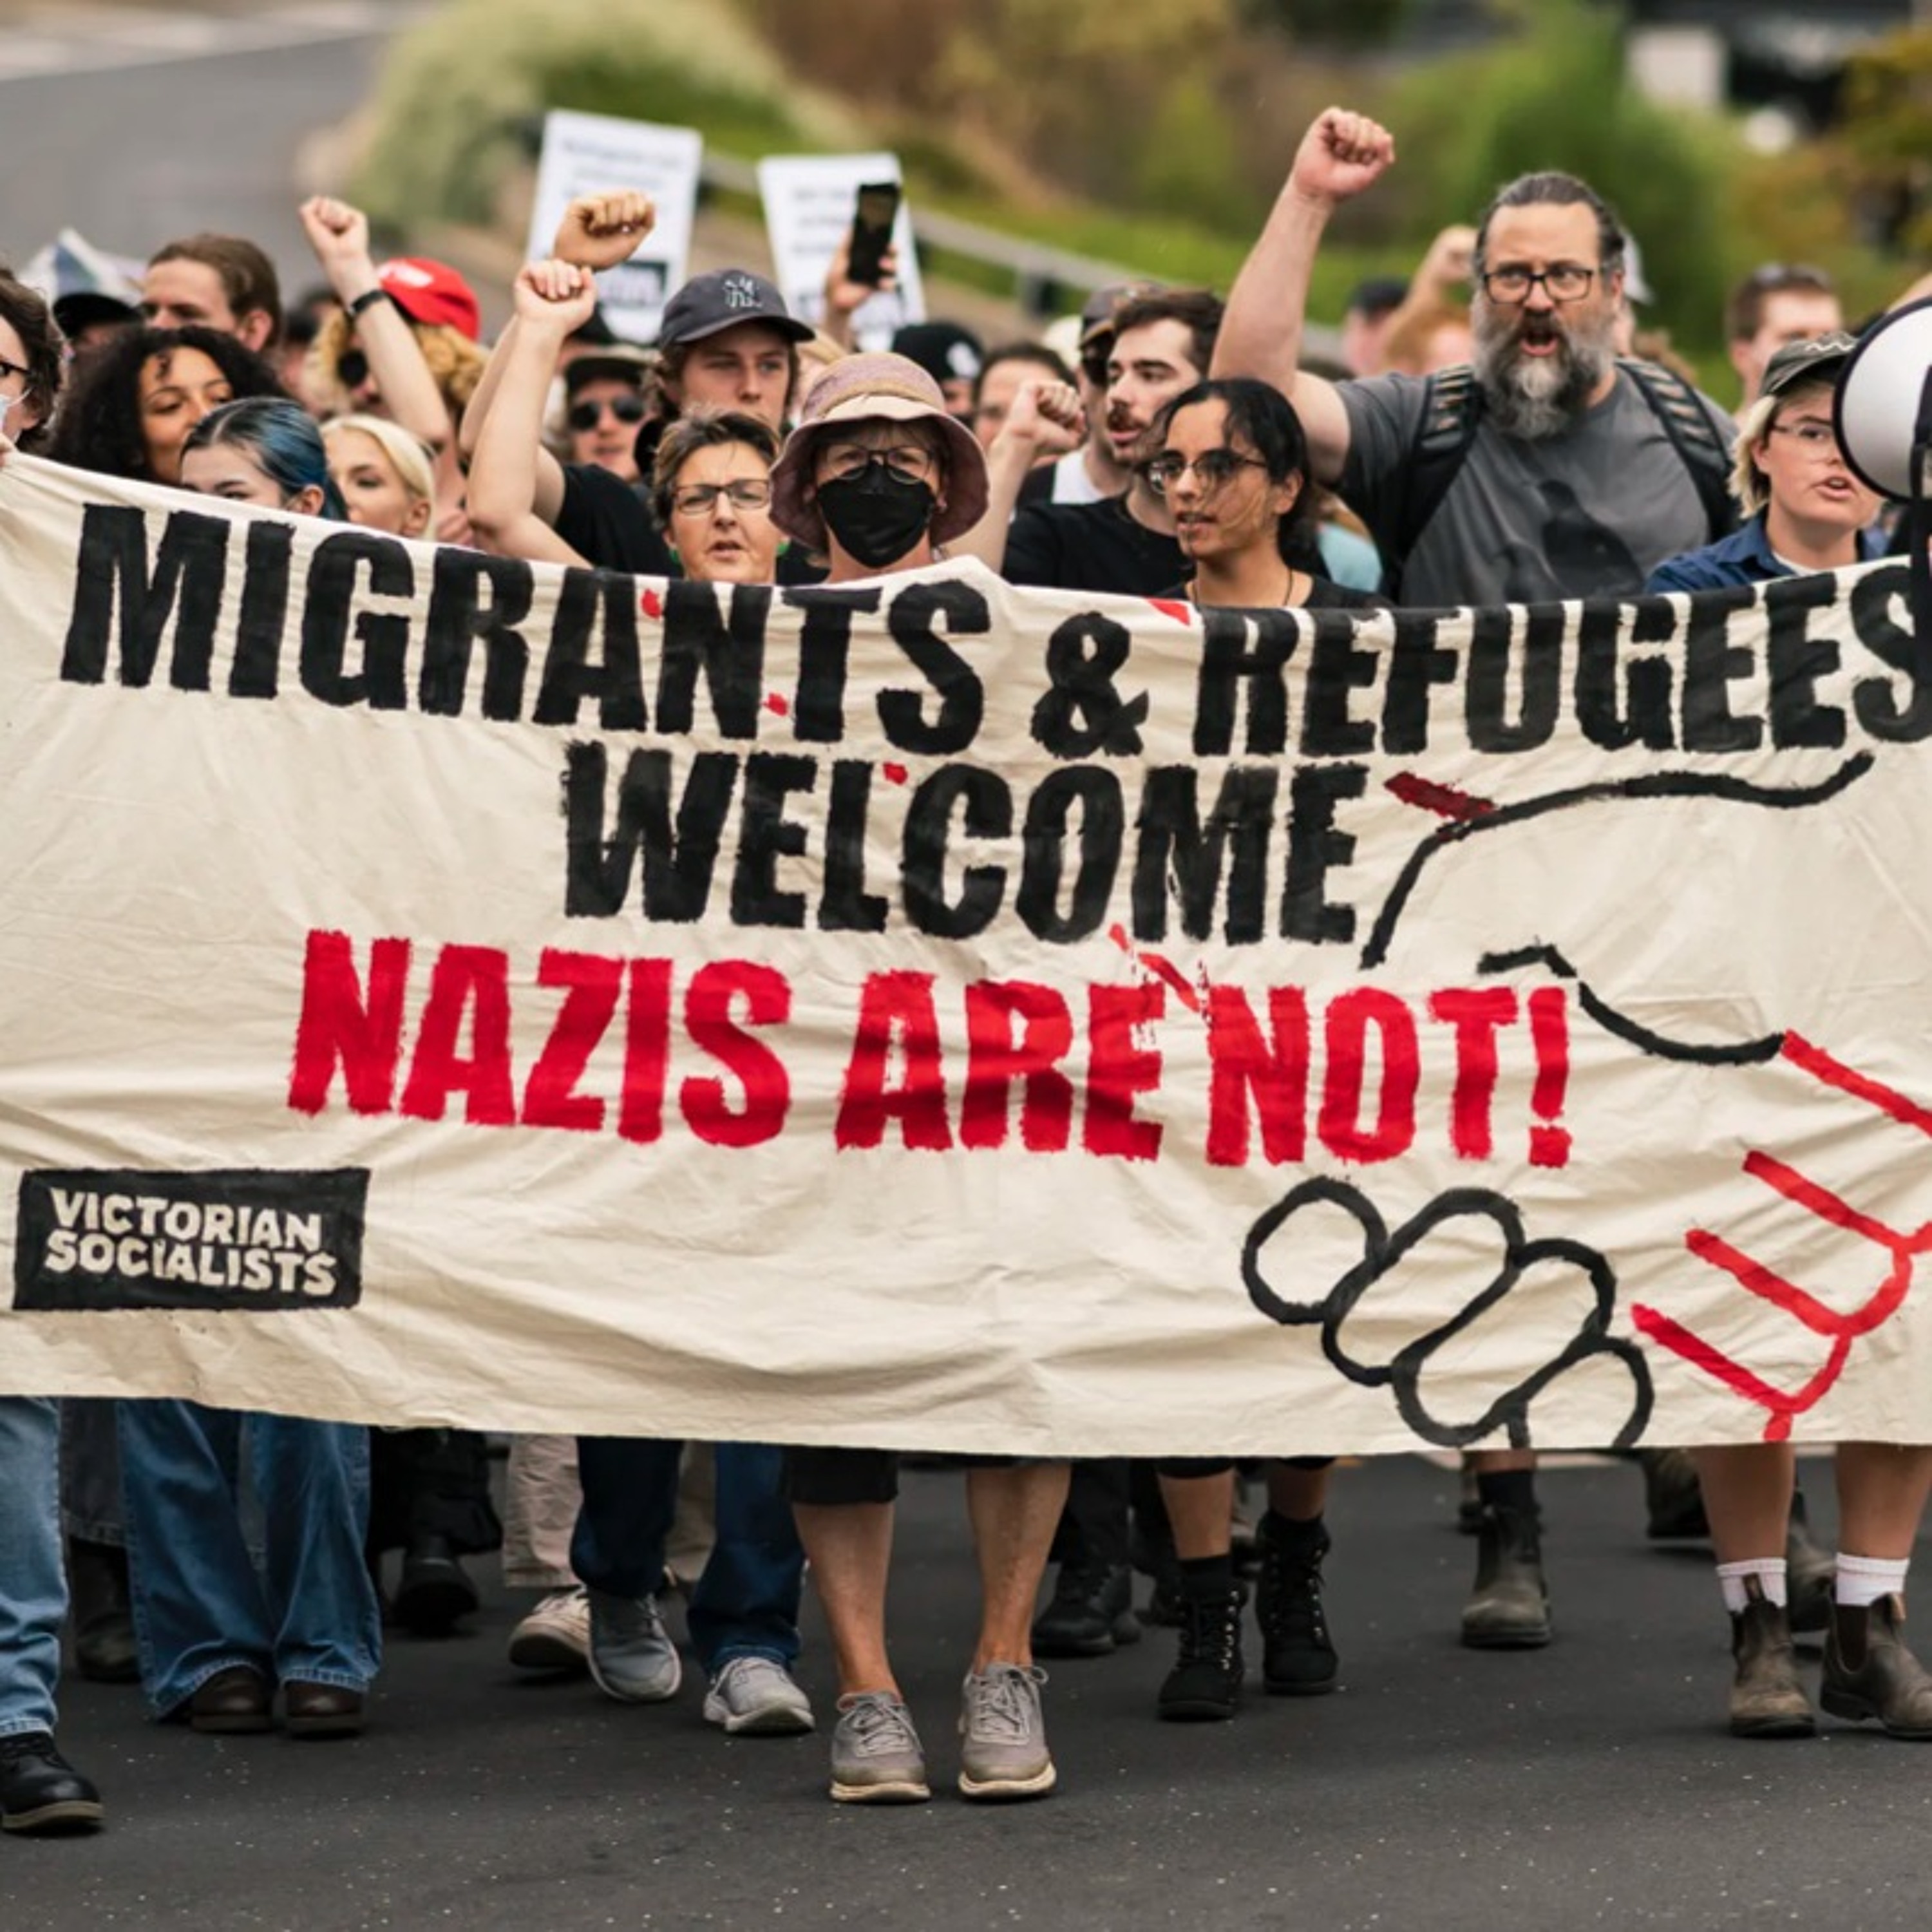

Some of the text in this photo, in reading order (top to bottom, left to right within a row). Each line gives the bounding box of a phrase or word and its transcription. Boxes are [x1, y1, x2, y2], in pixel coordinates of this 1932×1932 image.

[61, 503, 990, 755] MIGRANTS
[1031, 611, 1149, 758] &
[560, 741, 1368, 945] WELCOME
[287, 929, 1571, 1168] NAZIS ARE NOT!
[44, 1229, 337, 1297] SOCIALISTS
[50, 1188, 321, 1251] VICTORIAN
